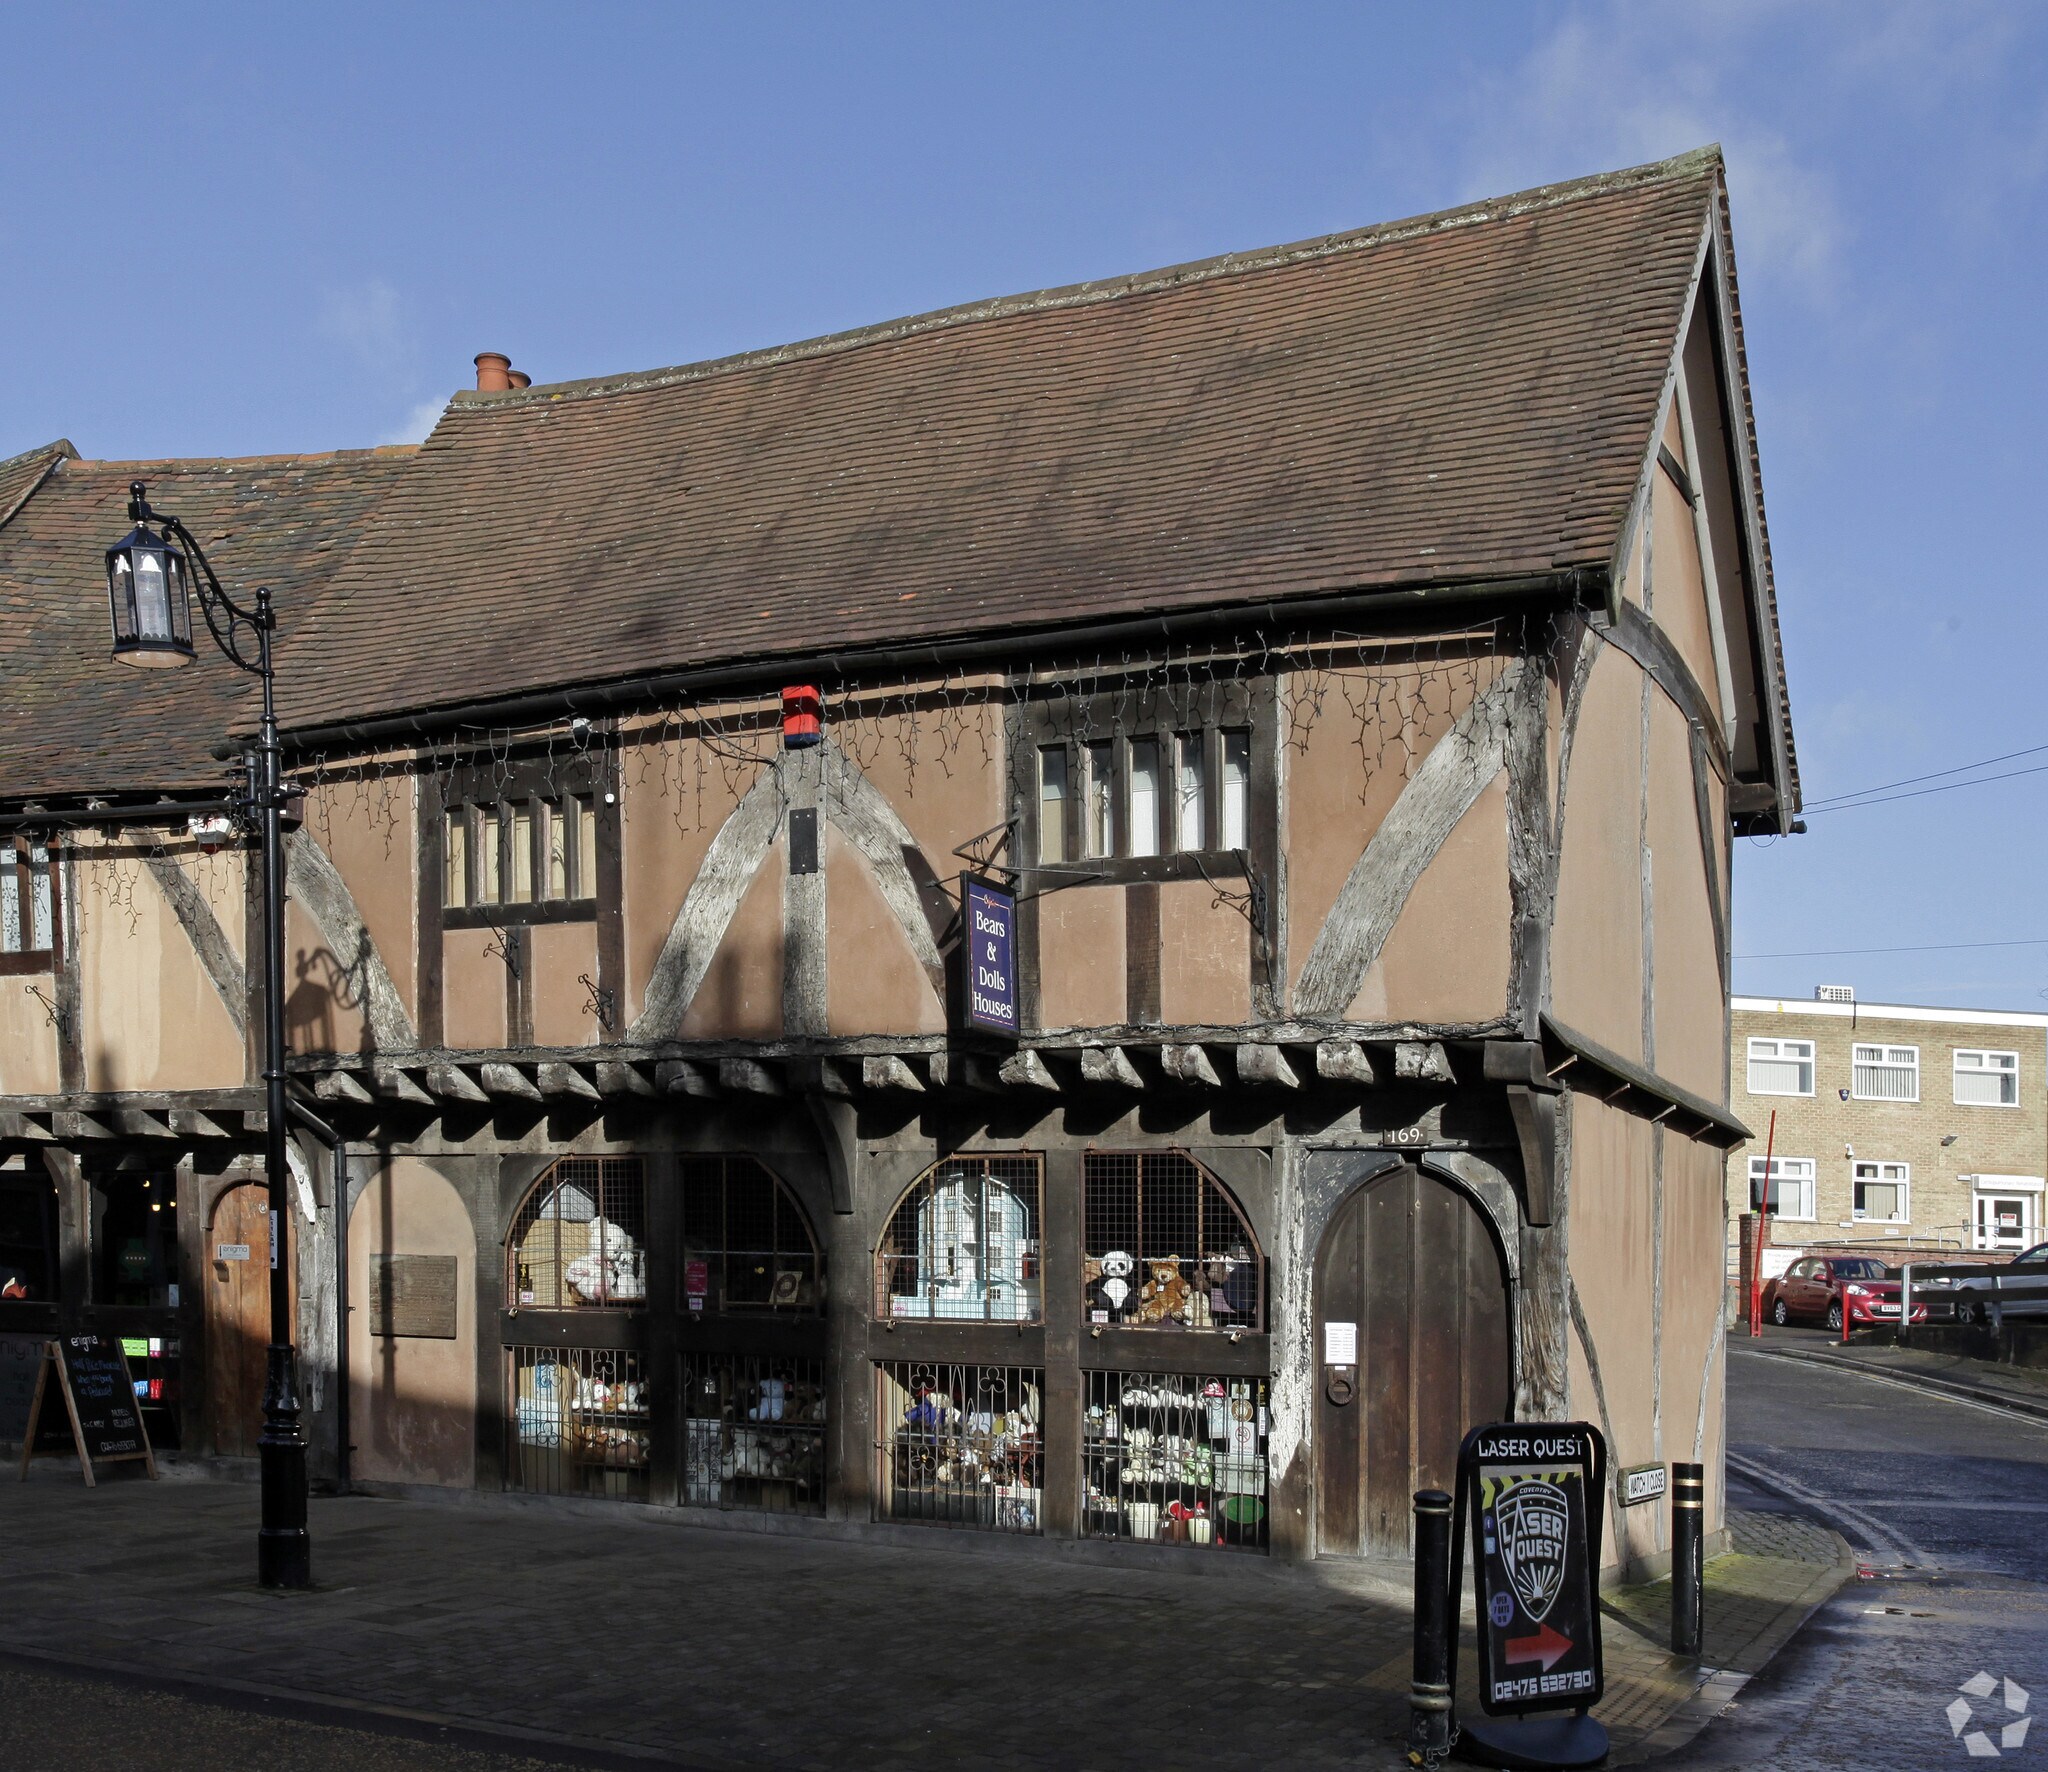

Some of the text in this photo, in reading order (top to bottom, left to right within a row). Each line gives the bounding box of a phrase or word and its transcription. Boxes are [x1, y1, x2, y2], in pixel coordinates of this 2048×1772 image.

[976, 910, 1005, 937] Bears
[987, 942, 997, 962] &
[979, 966, 1006, 991] Dolls
[974, 991, 1012, 1019] Houses
[1391, 1128, 1420, 1143] 169
[223, 1246, 248, 1254] enigma
[71, 1333, 98, 1352] enigma
[1478, 1439, 1583, 1458] LASER QUEST
[1520, 1486, 1552, 1494] COVENTRY
[1650, 1471, 1663, 1490] CLOSE
[1516, 1539, 1562, 1562] QUEST
[1495, 1669, 1592, 1700] 02476 632730
